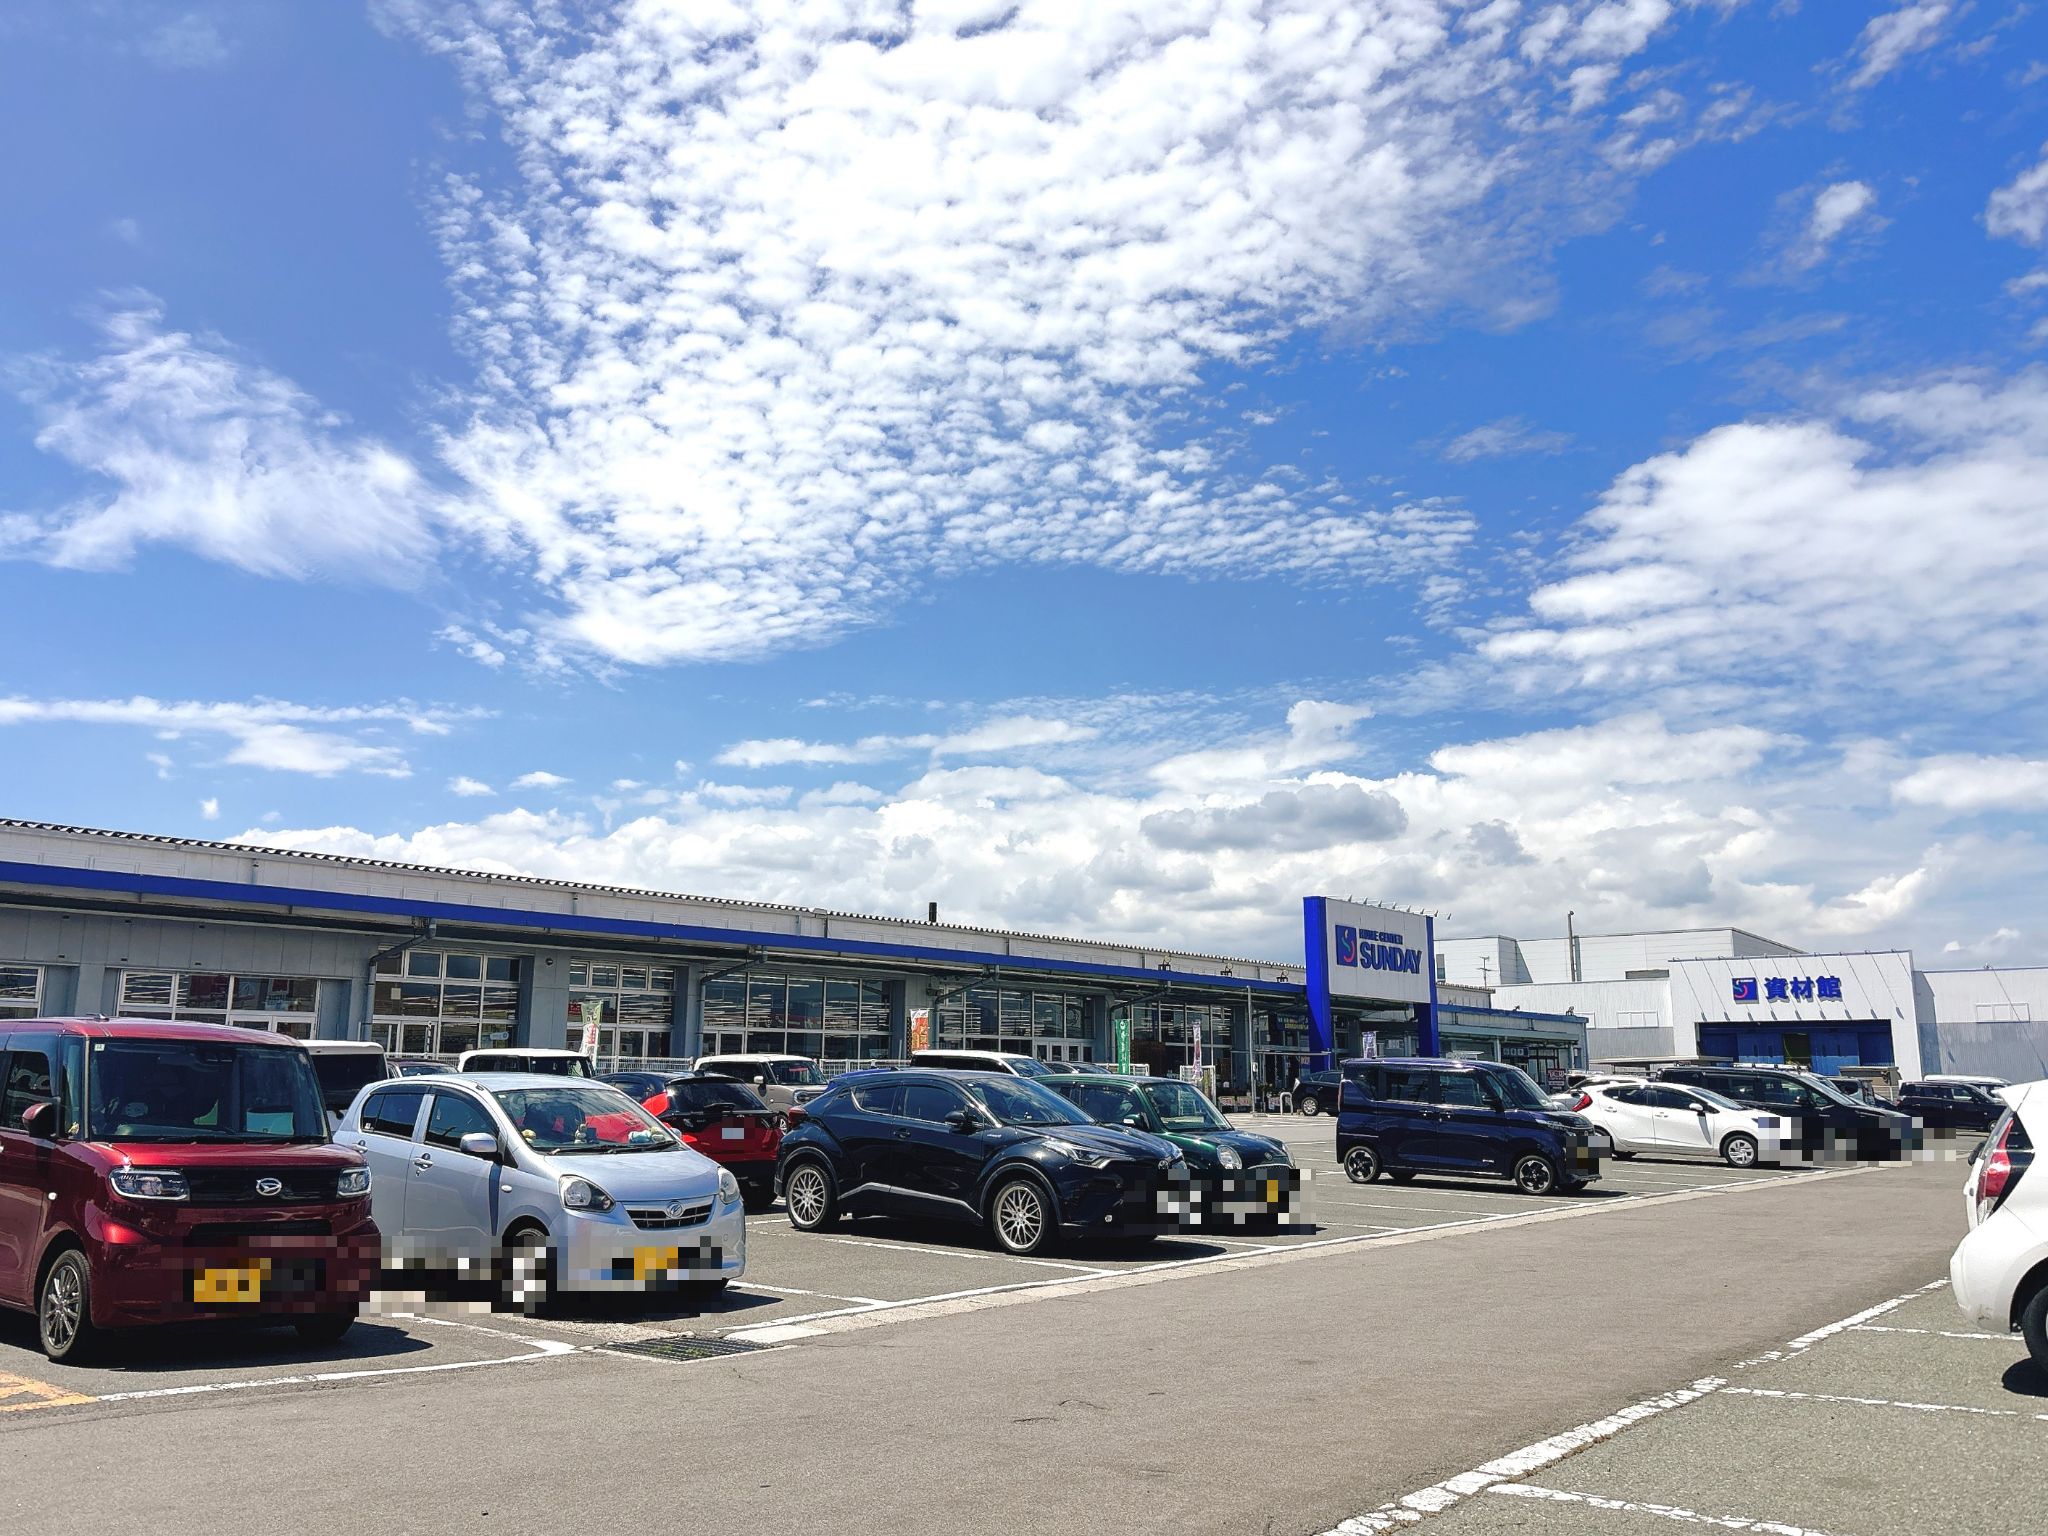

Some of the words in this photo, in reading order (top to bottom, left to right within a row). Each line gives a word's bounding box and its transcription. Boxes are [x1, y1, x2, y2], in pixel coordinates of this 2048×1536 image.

[1360, 941, 1422, 974] SUNDAY
[1764, 975, 1842, 1001] 資材館
